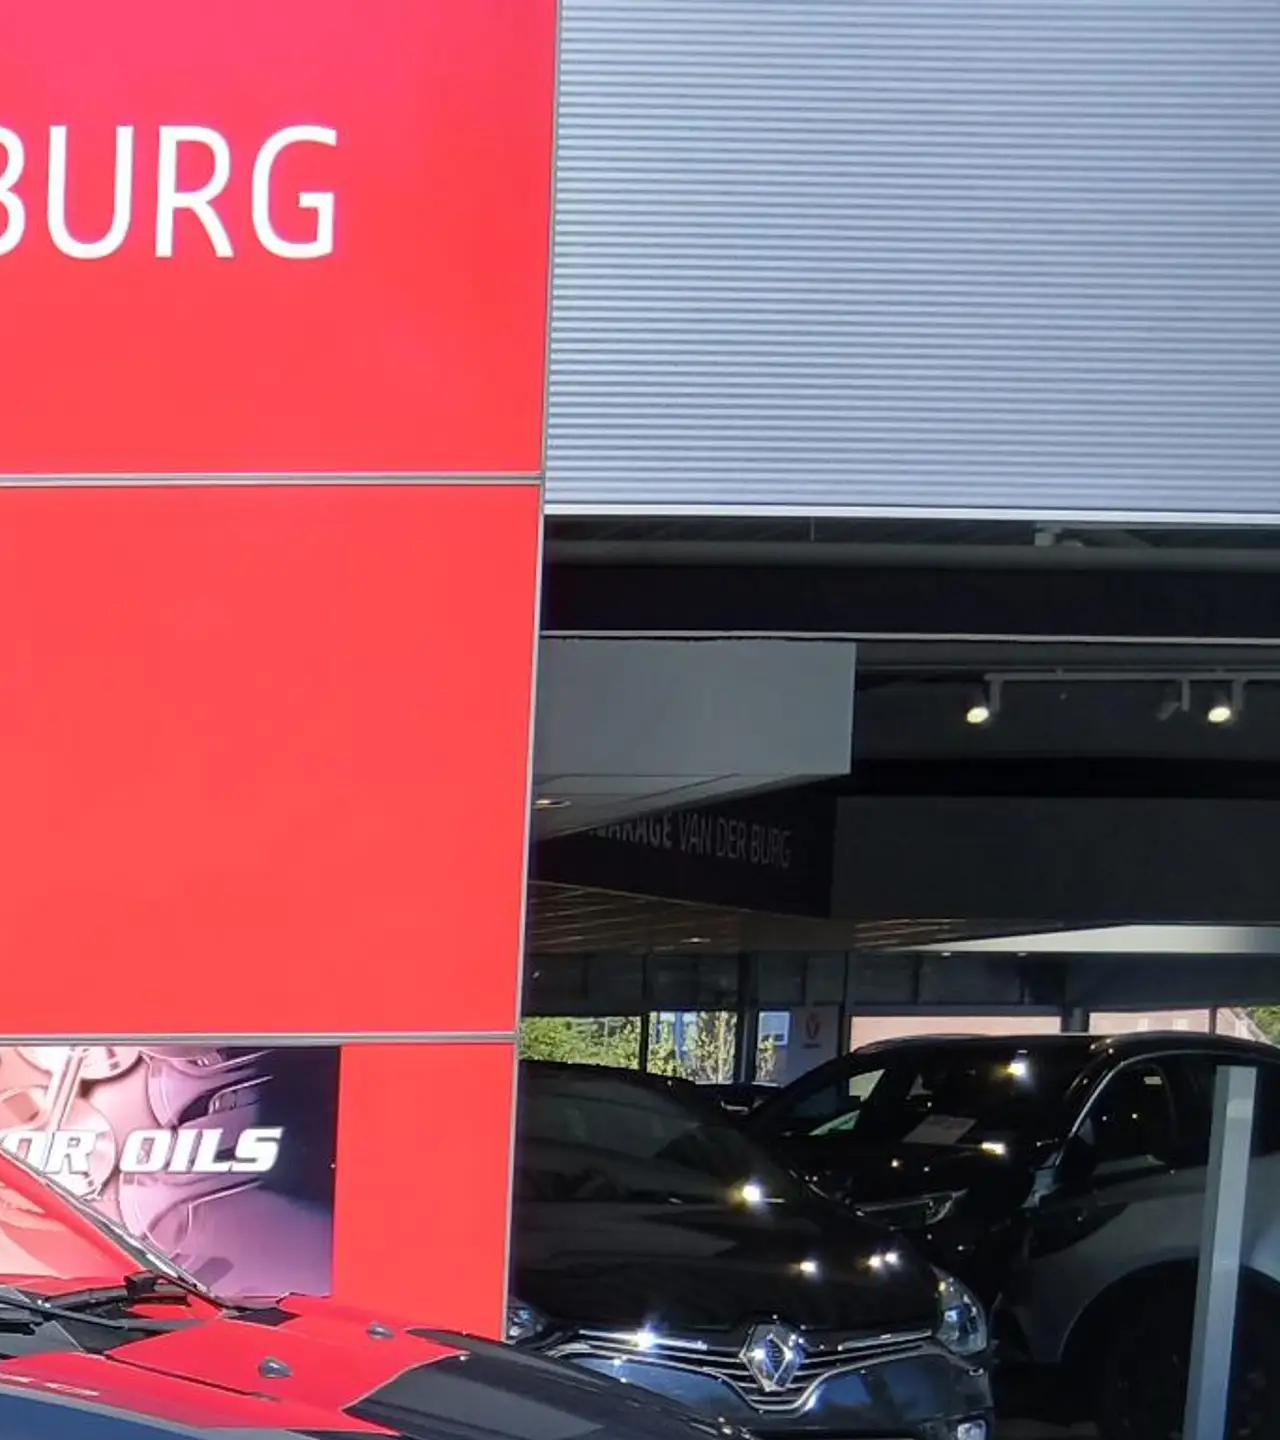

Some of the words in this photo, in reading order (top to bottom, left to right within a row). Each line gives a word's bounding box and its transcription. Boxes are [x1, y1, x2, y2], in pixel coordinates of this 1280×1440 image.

[677, 811, 713, 856] VAN
[716, 816, 748, 861] DER
[118, 1126, 286, 1175] OILS
